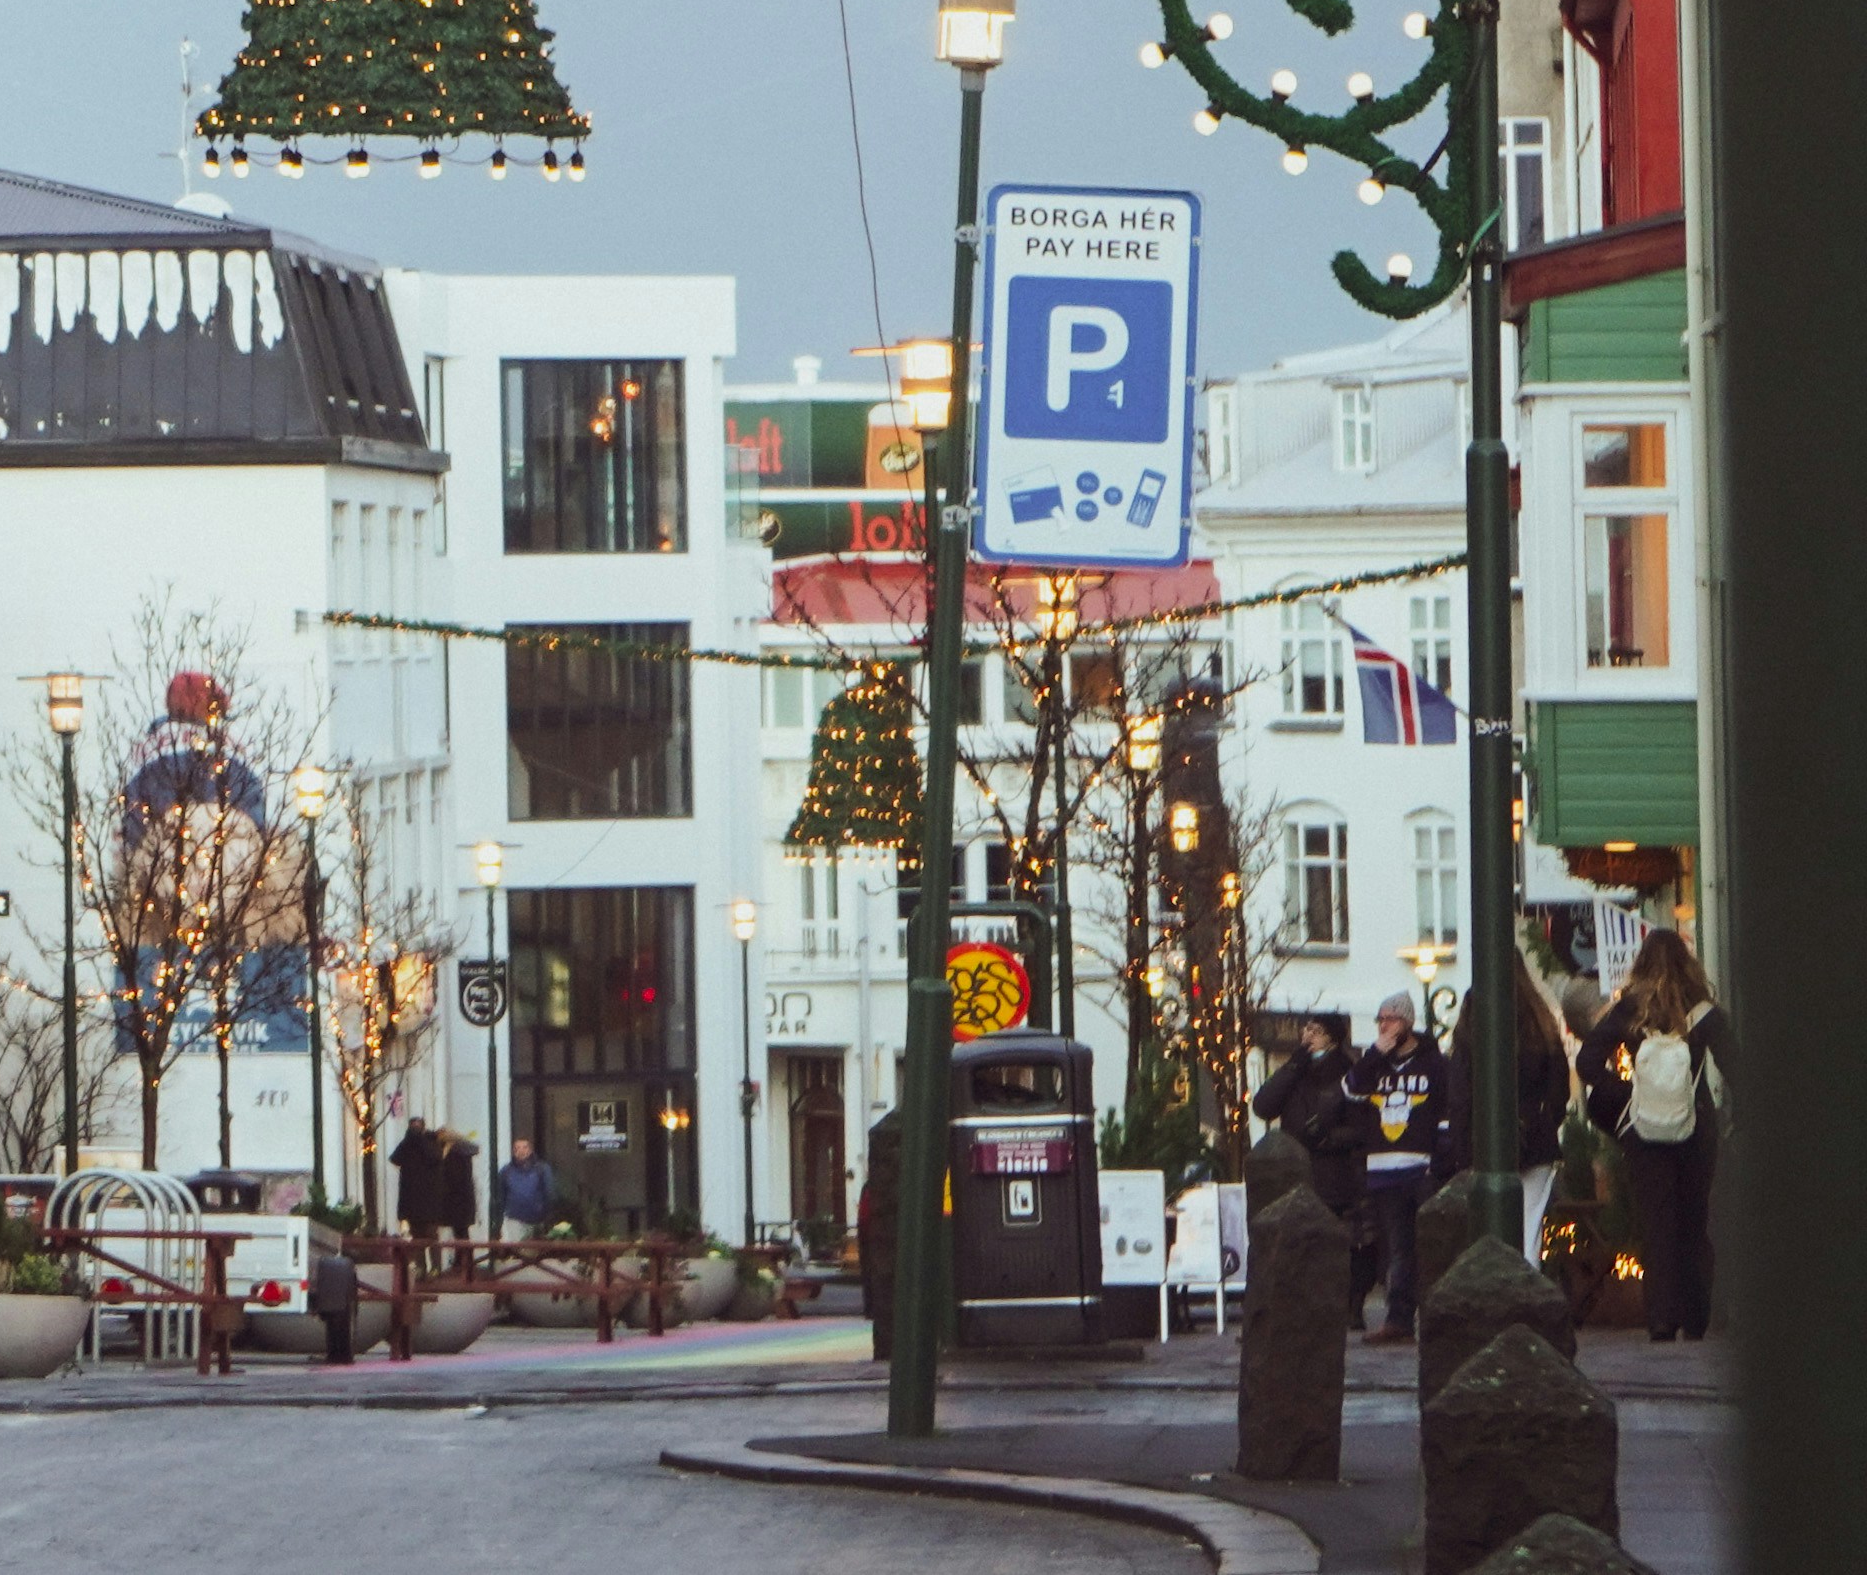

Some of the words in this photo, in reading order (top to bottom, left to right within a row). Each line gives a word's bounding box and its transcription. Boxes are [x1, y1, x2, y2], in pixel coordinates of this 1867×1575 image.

[1011, 207, 1108, 228] BORGA
[1120, 206, 1175, 231] HÉR
[1026, 237, 1074, 257] PAY
[1086, 240, 1160, 260] HERE
